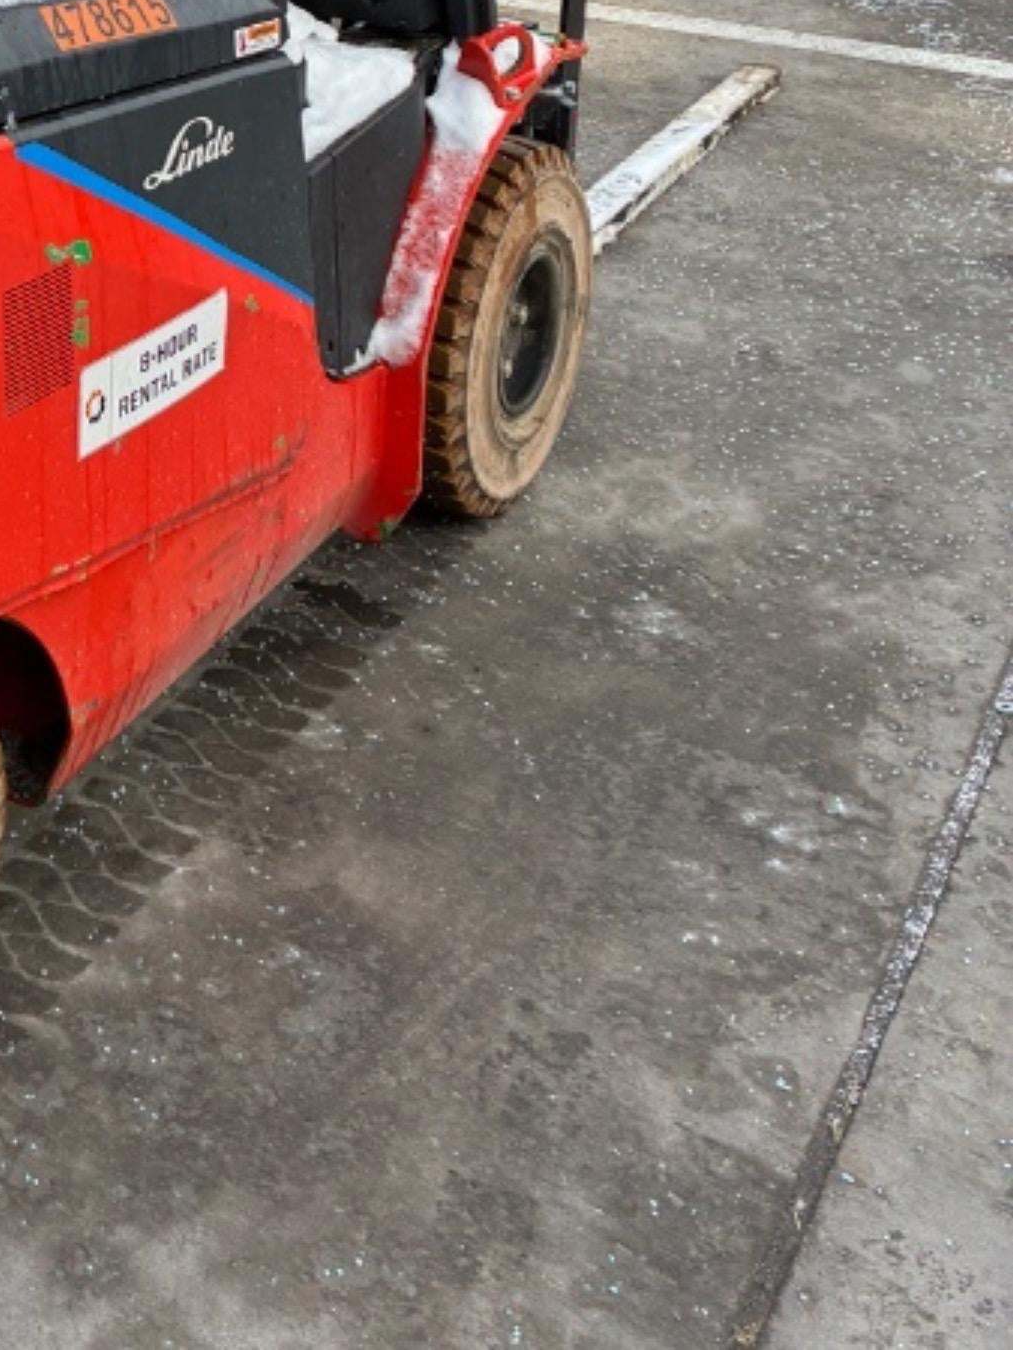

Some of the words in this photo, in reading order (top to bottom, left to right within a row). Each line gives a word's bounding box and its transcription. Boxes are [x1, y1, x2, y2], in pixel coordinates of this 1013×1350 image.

[142, 115, 234, 190] Linde
[118, 367, 179, 418] RENTAL
[182, 340, 217, 380] RATE
[139, 322, 198, 373] 8-HOUR
